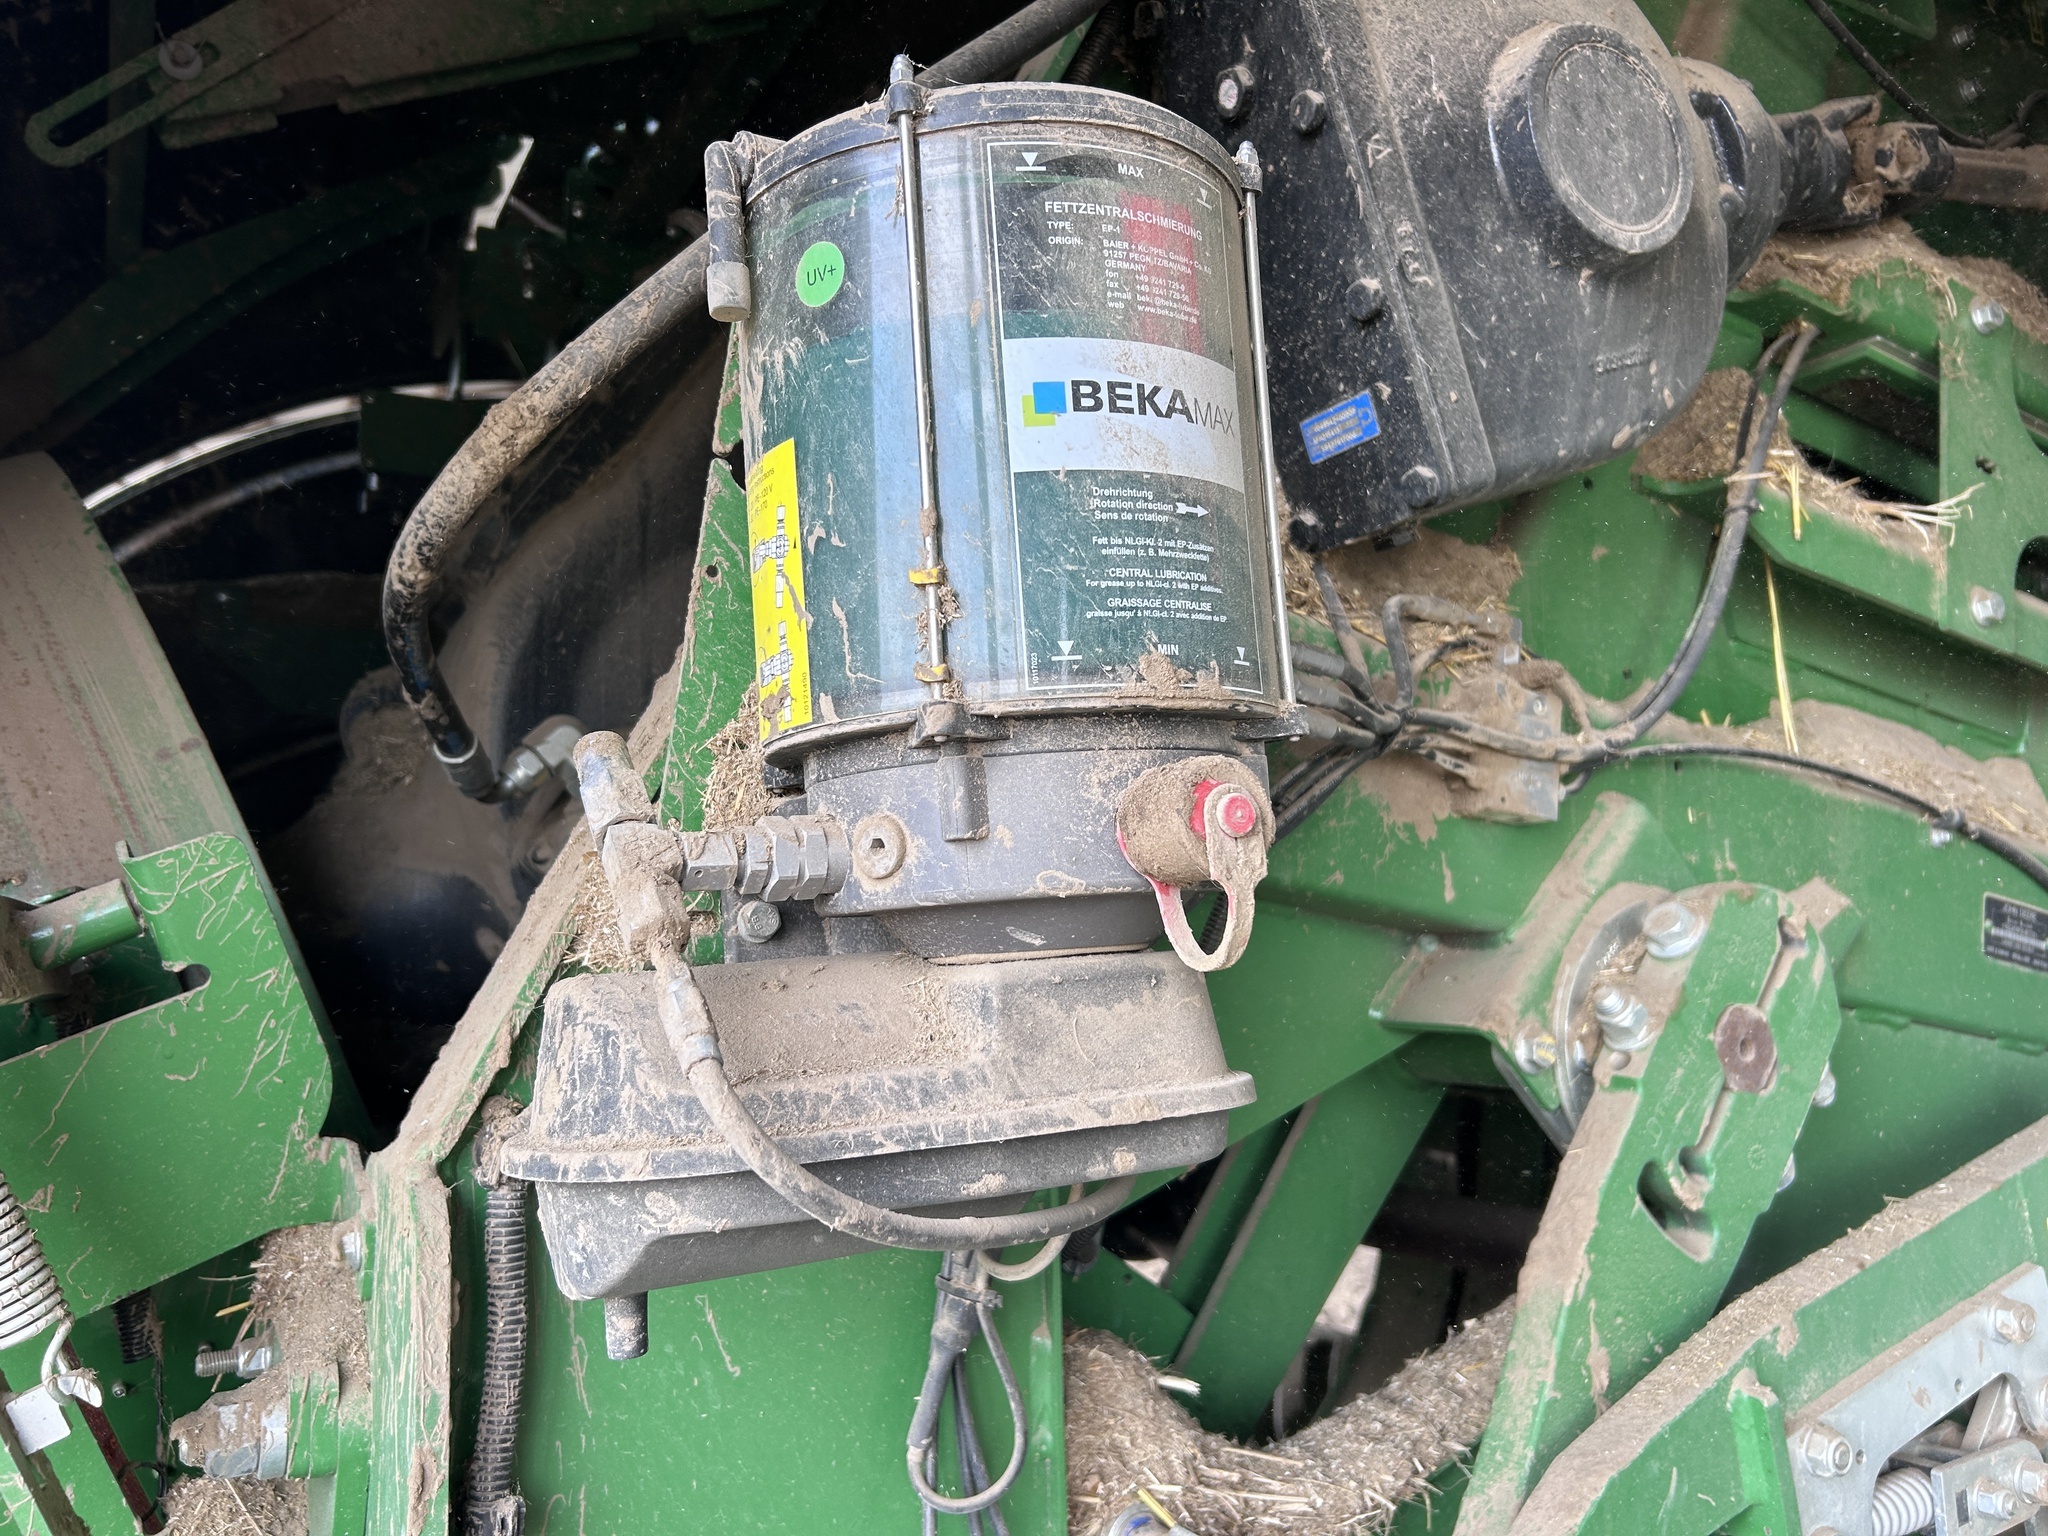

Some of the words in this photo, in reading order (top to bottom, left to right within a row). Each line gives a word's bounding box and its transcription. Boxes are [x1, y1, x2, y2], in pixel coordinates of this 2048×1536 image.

[1118, 163, 1144, 178] MAX
[1045, 201, 1203, 241] FETTZENTRALSCHMIERUNG
[1047, 221, 1074, 230] TYPE:
[1102, 224, 1120, 234] EP-1
[1048, 236, 1083, 246] ORIGIN:
[1103, 239, 1129, 250] BAIER
[1102, 249, 1127, 260] 91257
[1104, 259, 1146, 272] GERMANY
[807, 264, 837, 286] UV+
[1105, 269, 1119, 279] fon
[1106, 279, 1119, 289] fax
[1108, 300, 1125, 309] web
[1071, 379, 1235, 438] BEKAMAX
[1093, 486, 1153, 500] Drehrichtung
[1094, 499, 1134, 510] Rotation
[1136, 500, 1174, 511] direction
[1094, 510, 1118, 520] Sens
[1121, 511, 1133, 520] de
[1134, 512, 1169, 523] rotation
[1092, 536, 1108, 545] Fett
[1110, 536, 1122, 545] bis
[1158, 538, 1163, 547] 2
[1164, 539, 1176, 548] mit
[1101, 546, 1136, 556] einfüllen
[1148, 548, 1157, 557] B.
[1109, 567, 1153, 578] CENTRAL
[1155, 569, 1207, 582] LUBRICATION
[1086, 579, 1099, 587] For
[1100, 580, 1124, 589] grease
[1126, 580, 1136, 589] up
[1137, 580, 1145, 588] to
[1171, 581, 1177, 589] 2
[1190, 583, 1199, 591] EP
[1164, 599, 1212, 612] CENTRALISE
[1170, 610, 1175, 618] 2
[1157, 643, 1179, 656] MIN
[1031, 652, 1039, 685] 10117023
